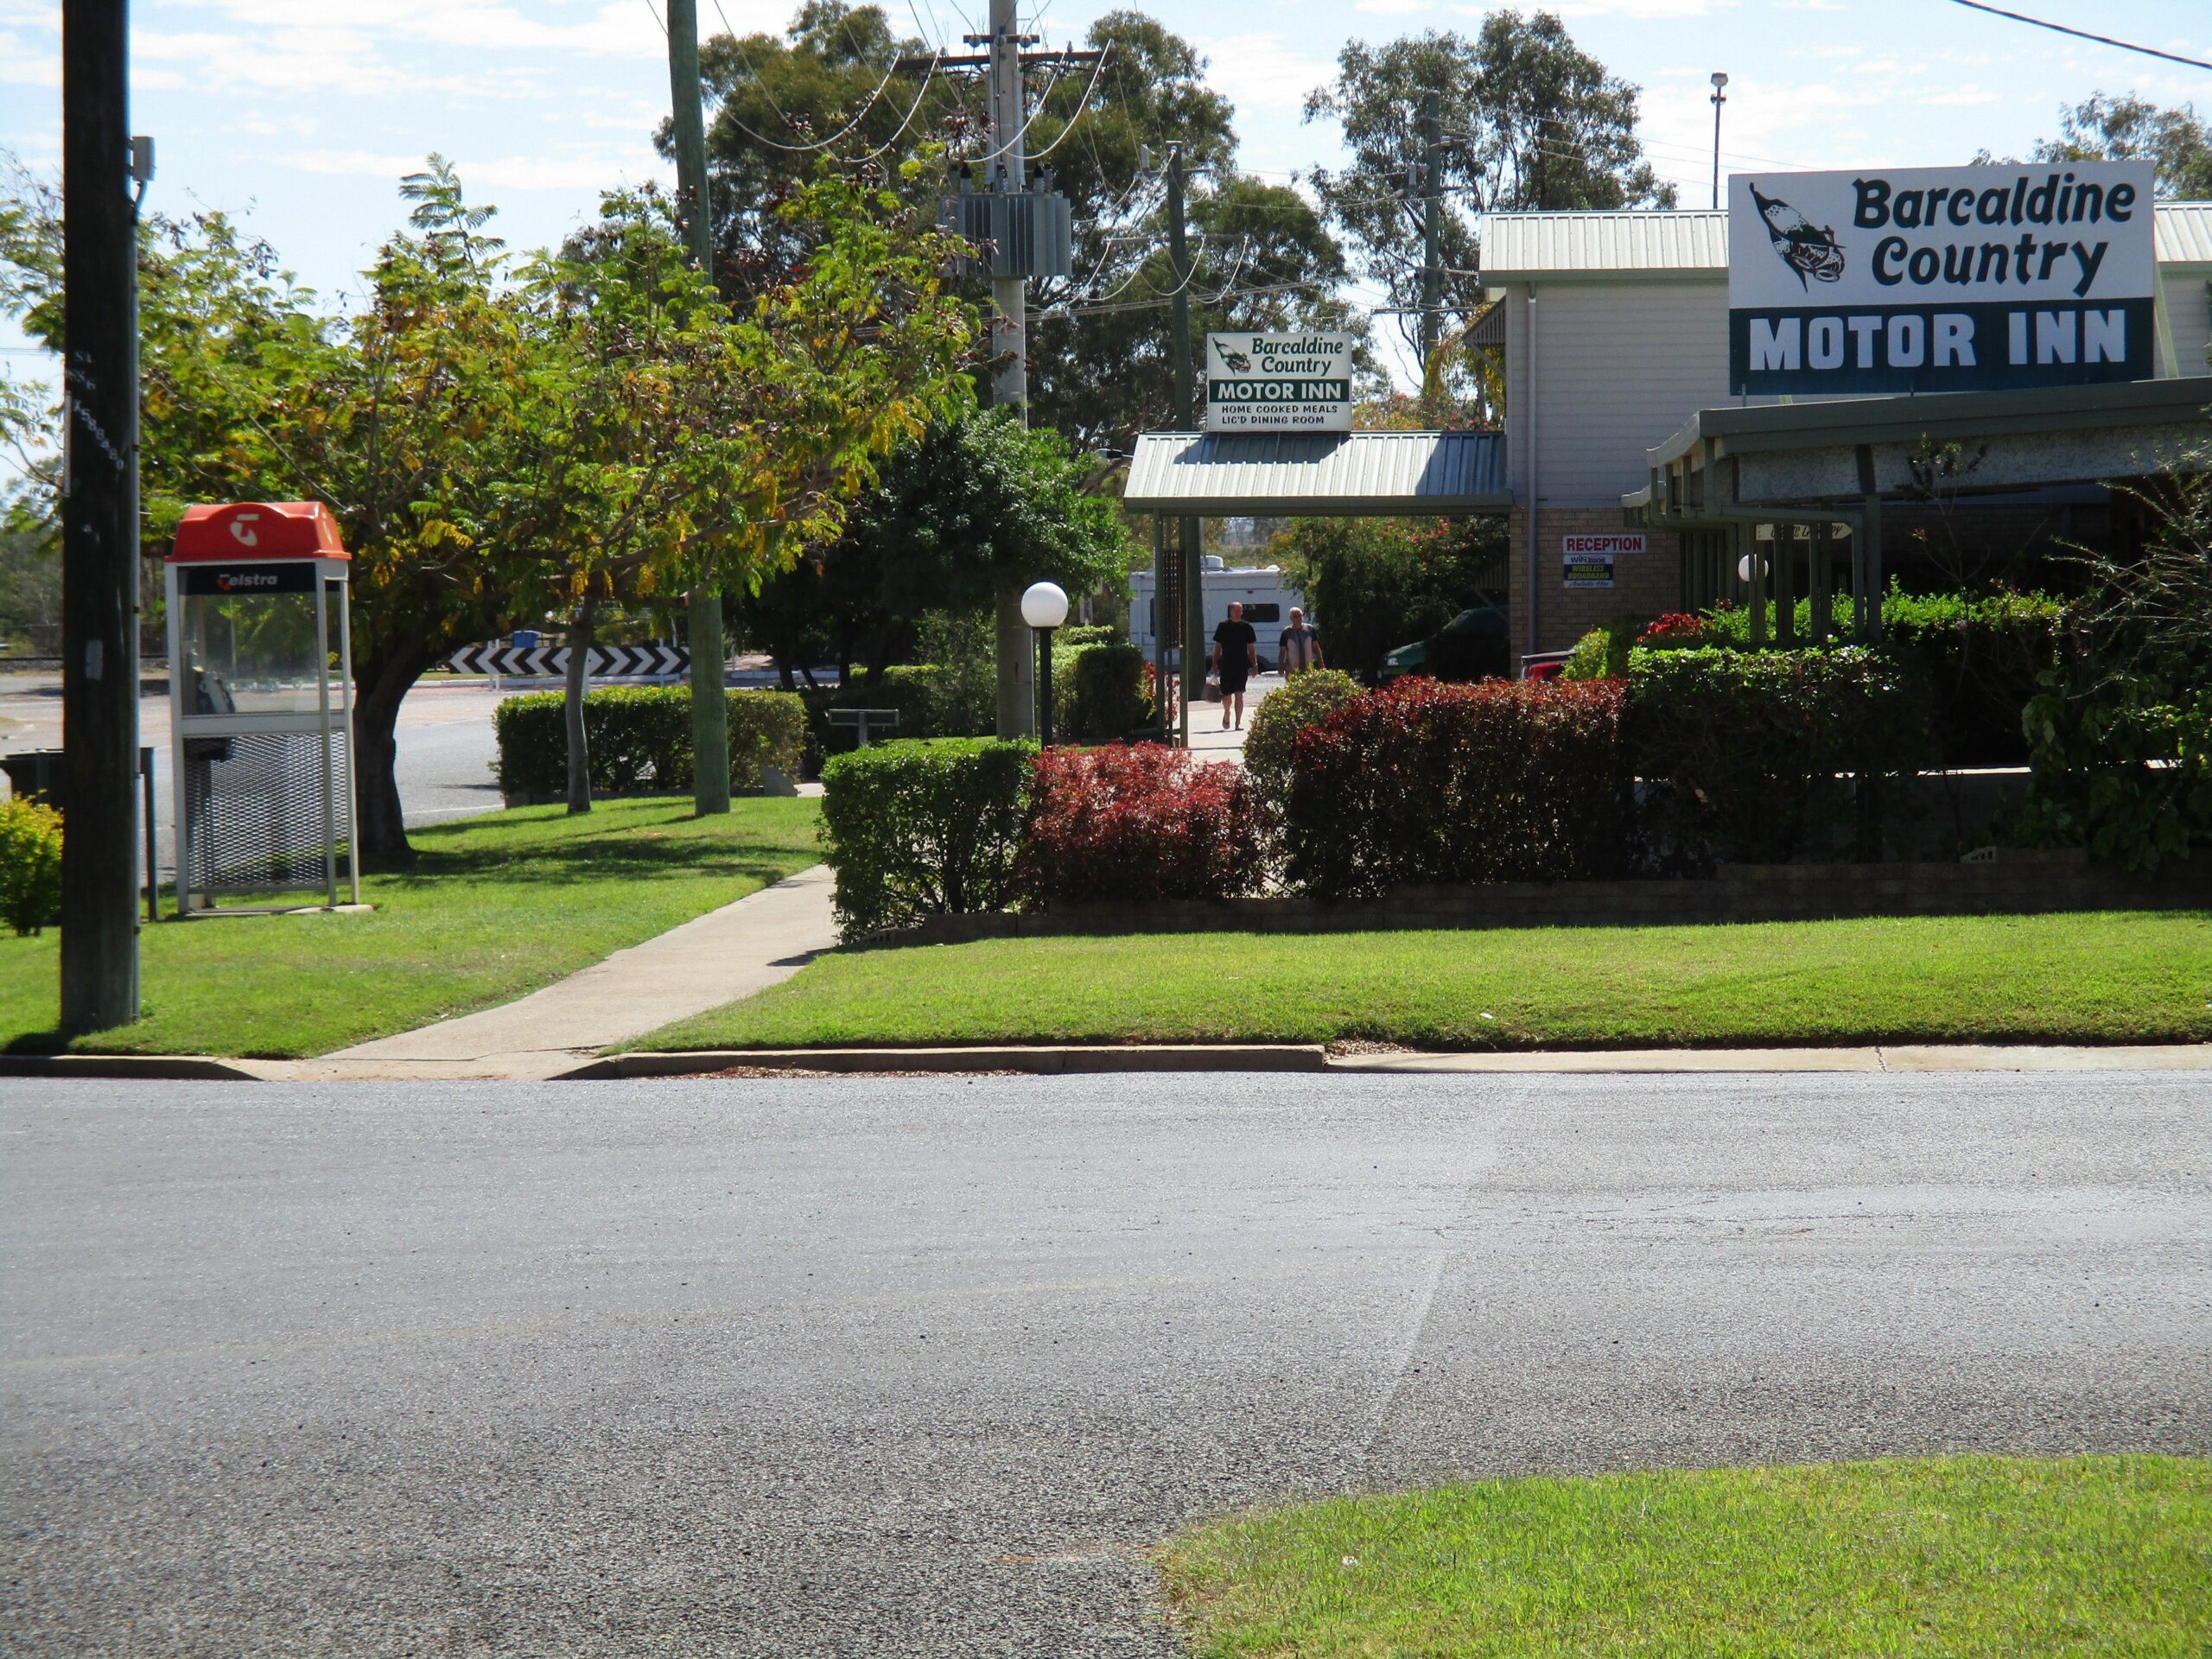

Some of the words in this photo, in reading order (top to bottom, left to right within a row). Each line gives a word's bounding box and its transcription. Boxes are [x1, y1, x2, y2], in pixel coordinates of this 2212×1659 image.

[1852, 174, 2137, 229] Barcaldine
[1872, 233, 2110, 298] Country
[1251, 336, 1344, 355] Barcaldine
[1749, 313, 1977, 372] MOTOR
[2008, 309, 2126, 365] INN
[1262, 356, 1332, 377] Country
[1217, 382, 1294, 400] MOTOR
[1301, 382, 1342, 400] INN
[1222, 405, 1252, 414] HOME
[1255, 404, 1299, 414] COOKED
[1303, 404, 1338, 414] MEALS
[1222, 416, 1247, 424] LIC'D
[1251, 416, 1288, 424] DINING
[1292, 416, 1325, 424] ROOM
[1567, 537, 1642, 551] RECEPTION
[218, 573, 278, 591] Telstra
